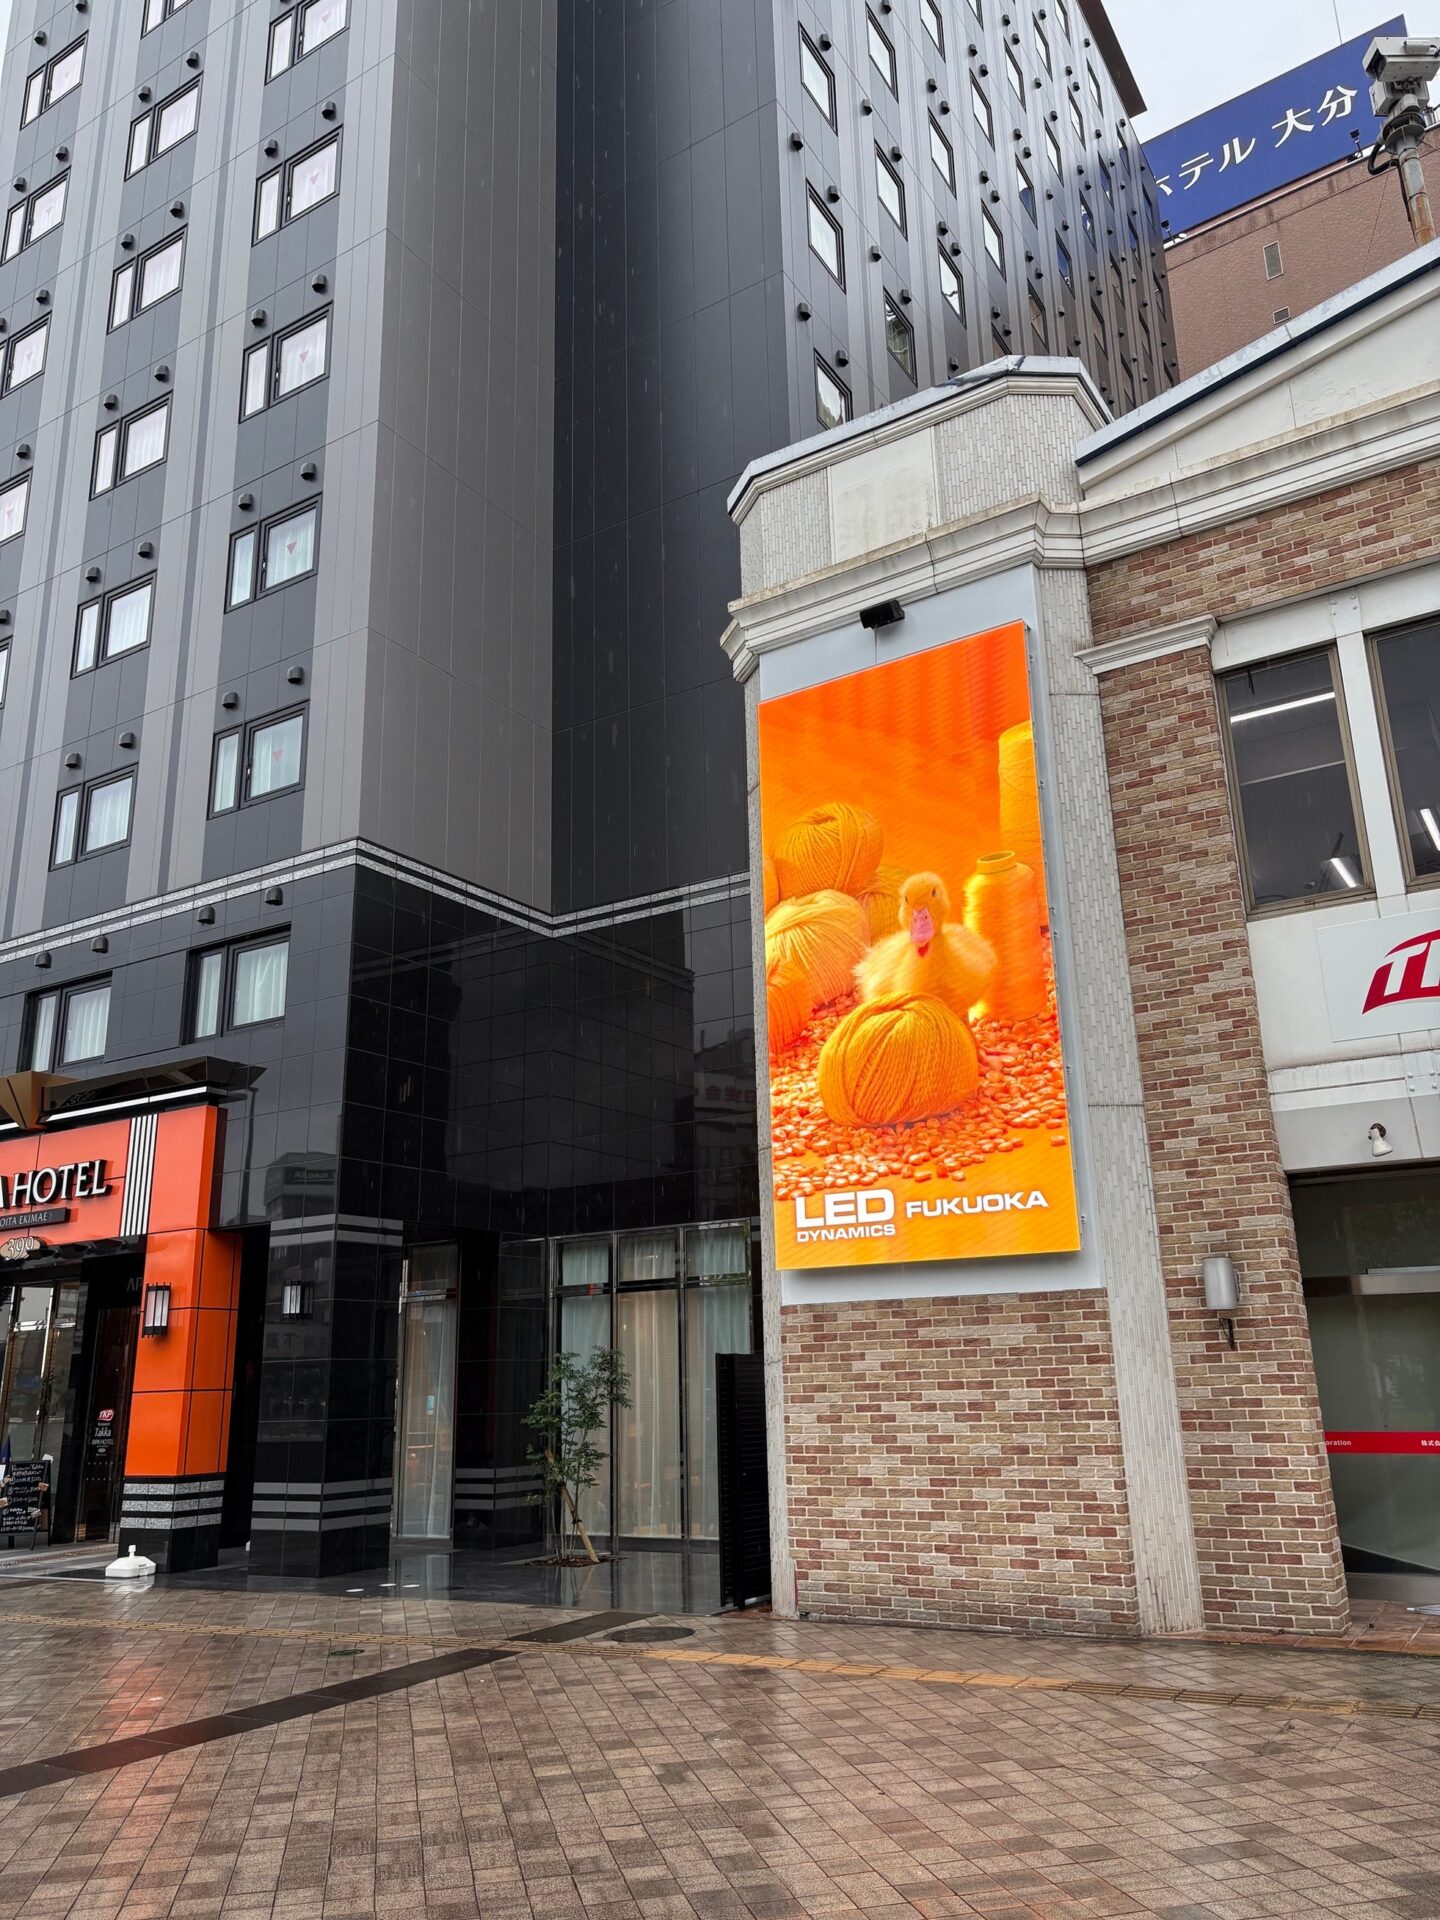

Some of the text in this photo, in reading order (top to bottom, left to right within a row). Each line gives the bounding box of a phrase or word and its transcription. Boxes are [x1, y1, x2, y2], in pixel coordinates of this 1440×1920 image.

[1271, 85, 1358, 148] 大分
[10, 1159, 107, 1207] HOTEL
[0, 1217, 17, 1227] OITA
[795, 1188, 1049, 1228] LED FUKUOKA
[796, 1223, 896, 1243] DYNAMICS
